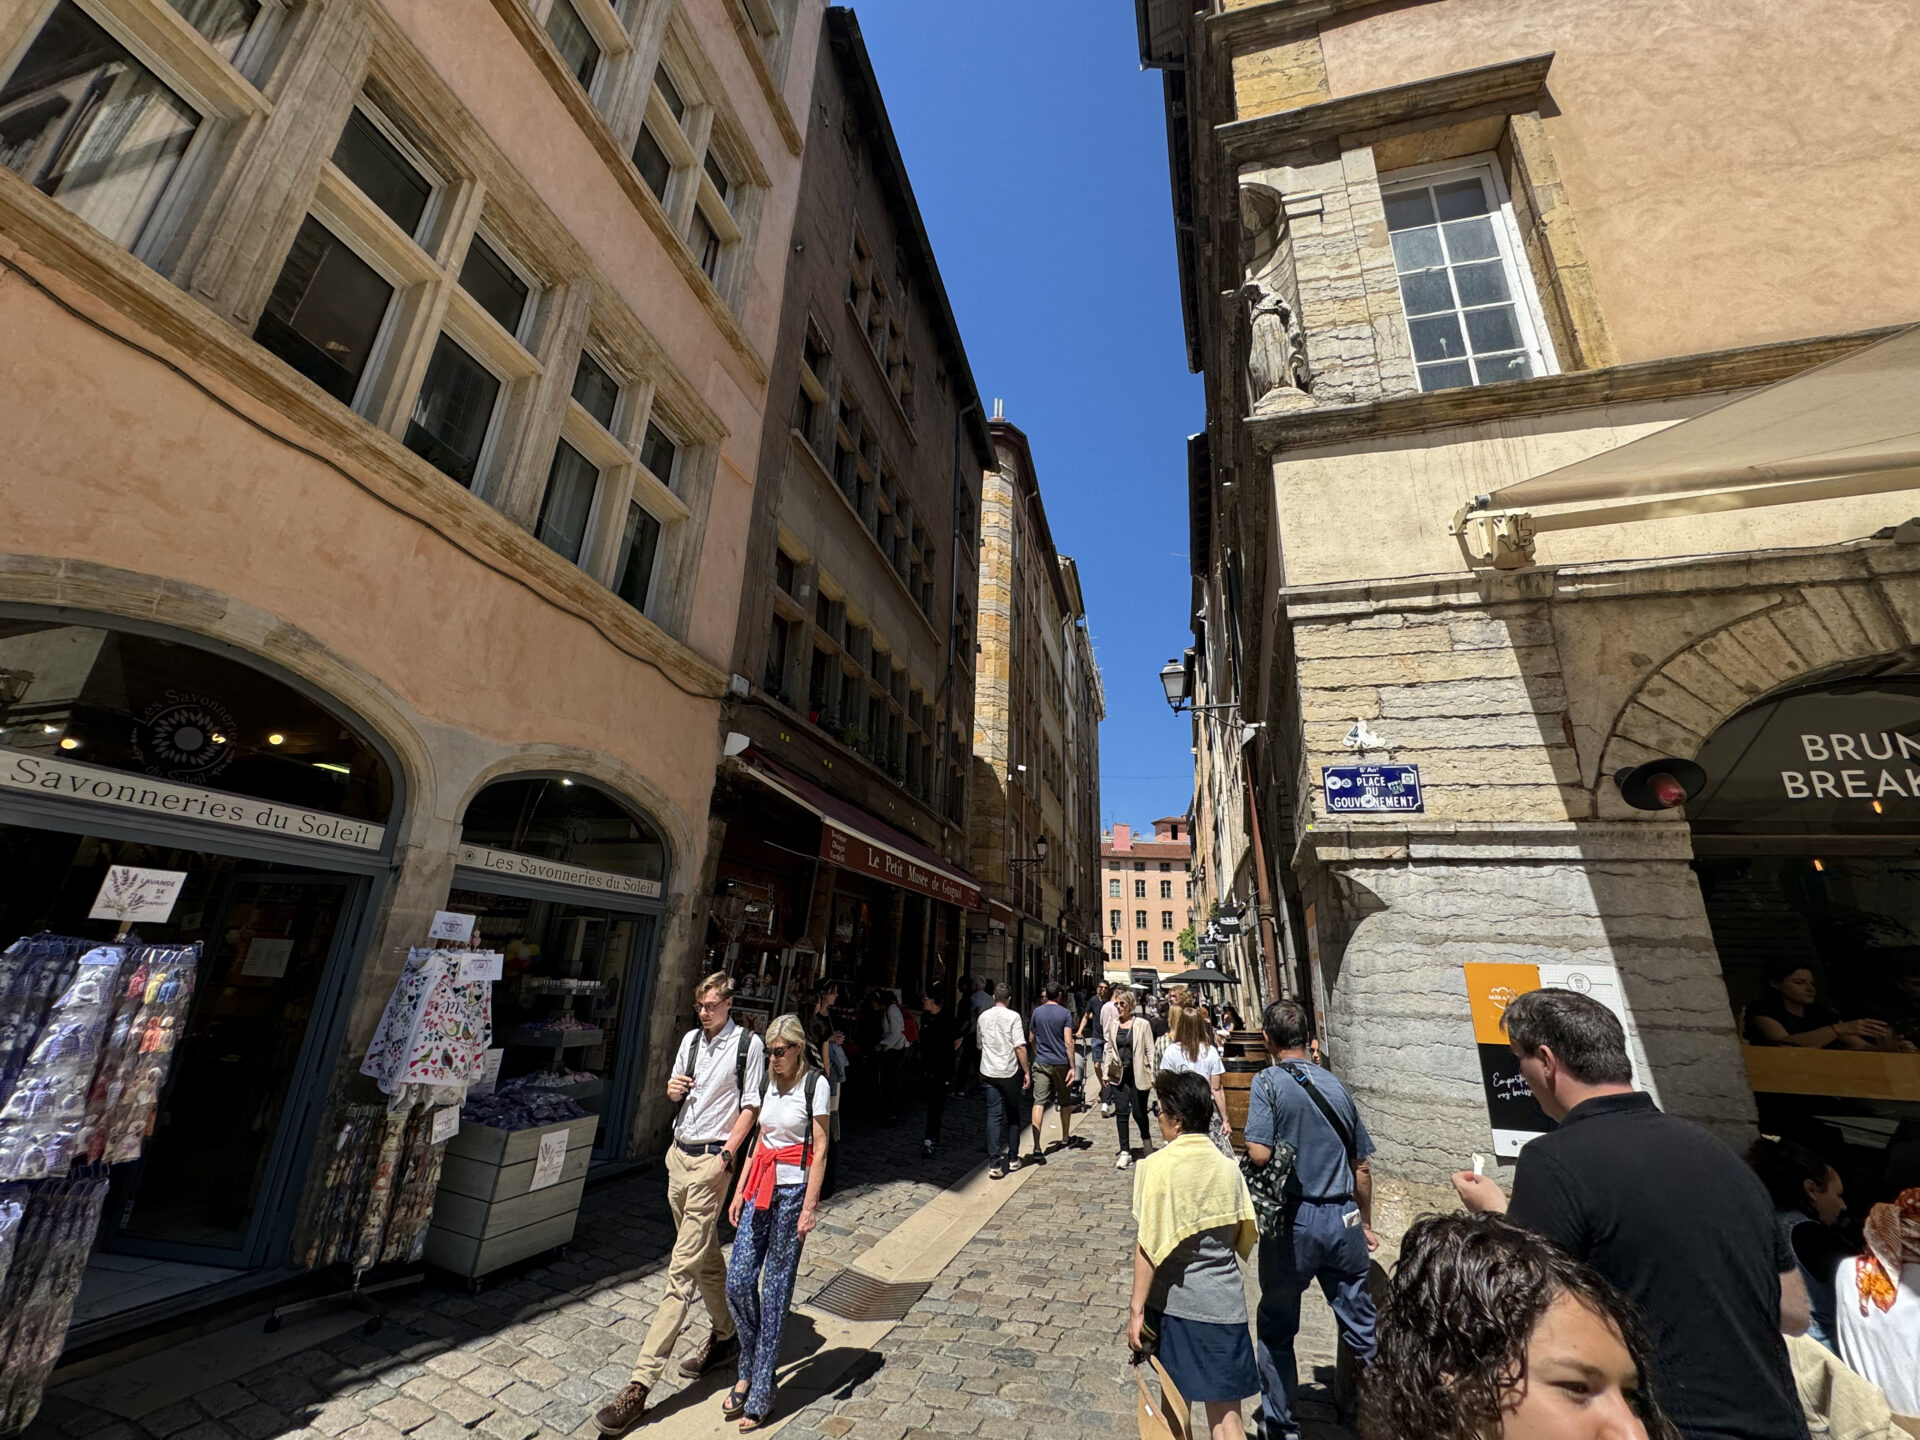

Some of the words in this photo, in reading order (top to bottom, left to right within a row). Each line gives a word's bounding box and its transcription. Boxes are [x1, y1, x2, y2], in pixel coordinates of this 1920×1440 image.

[164, 689, 239, 748] Savonneries
[1356, 776, 1386, 787] PLACE
[1365, 787, 1379, 796] DU
[10, 758, 244, 822] Savonneries
[256, 807, 289, 830] du
[298, 813, 369, 844] Soleil
[1334, 796, 1414, 808] GOUVNEMENT
[484, 851, 513, 870] Les
[519, 858, 602, 886] Savonneries
[606, 875, 620, 890] du
[623, 877, 654, 895] Soleil
[868, 847, 880, 869] Le
[885, 855, 904, 878] Petit
[908, 864, 929, 888] Musée
[931, 875, 939, 891] de
[942, 879, 962, 903] Guignol
[141, 878, 176, 888] LAVANDE
[1512, 1086, 1532, 1097] boiss
